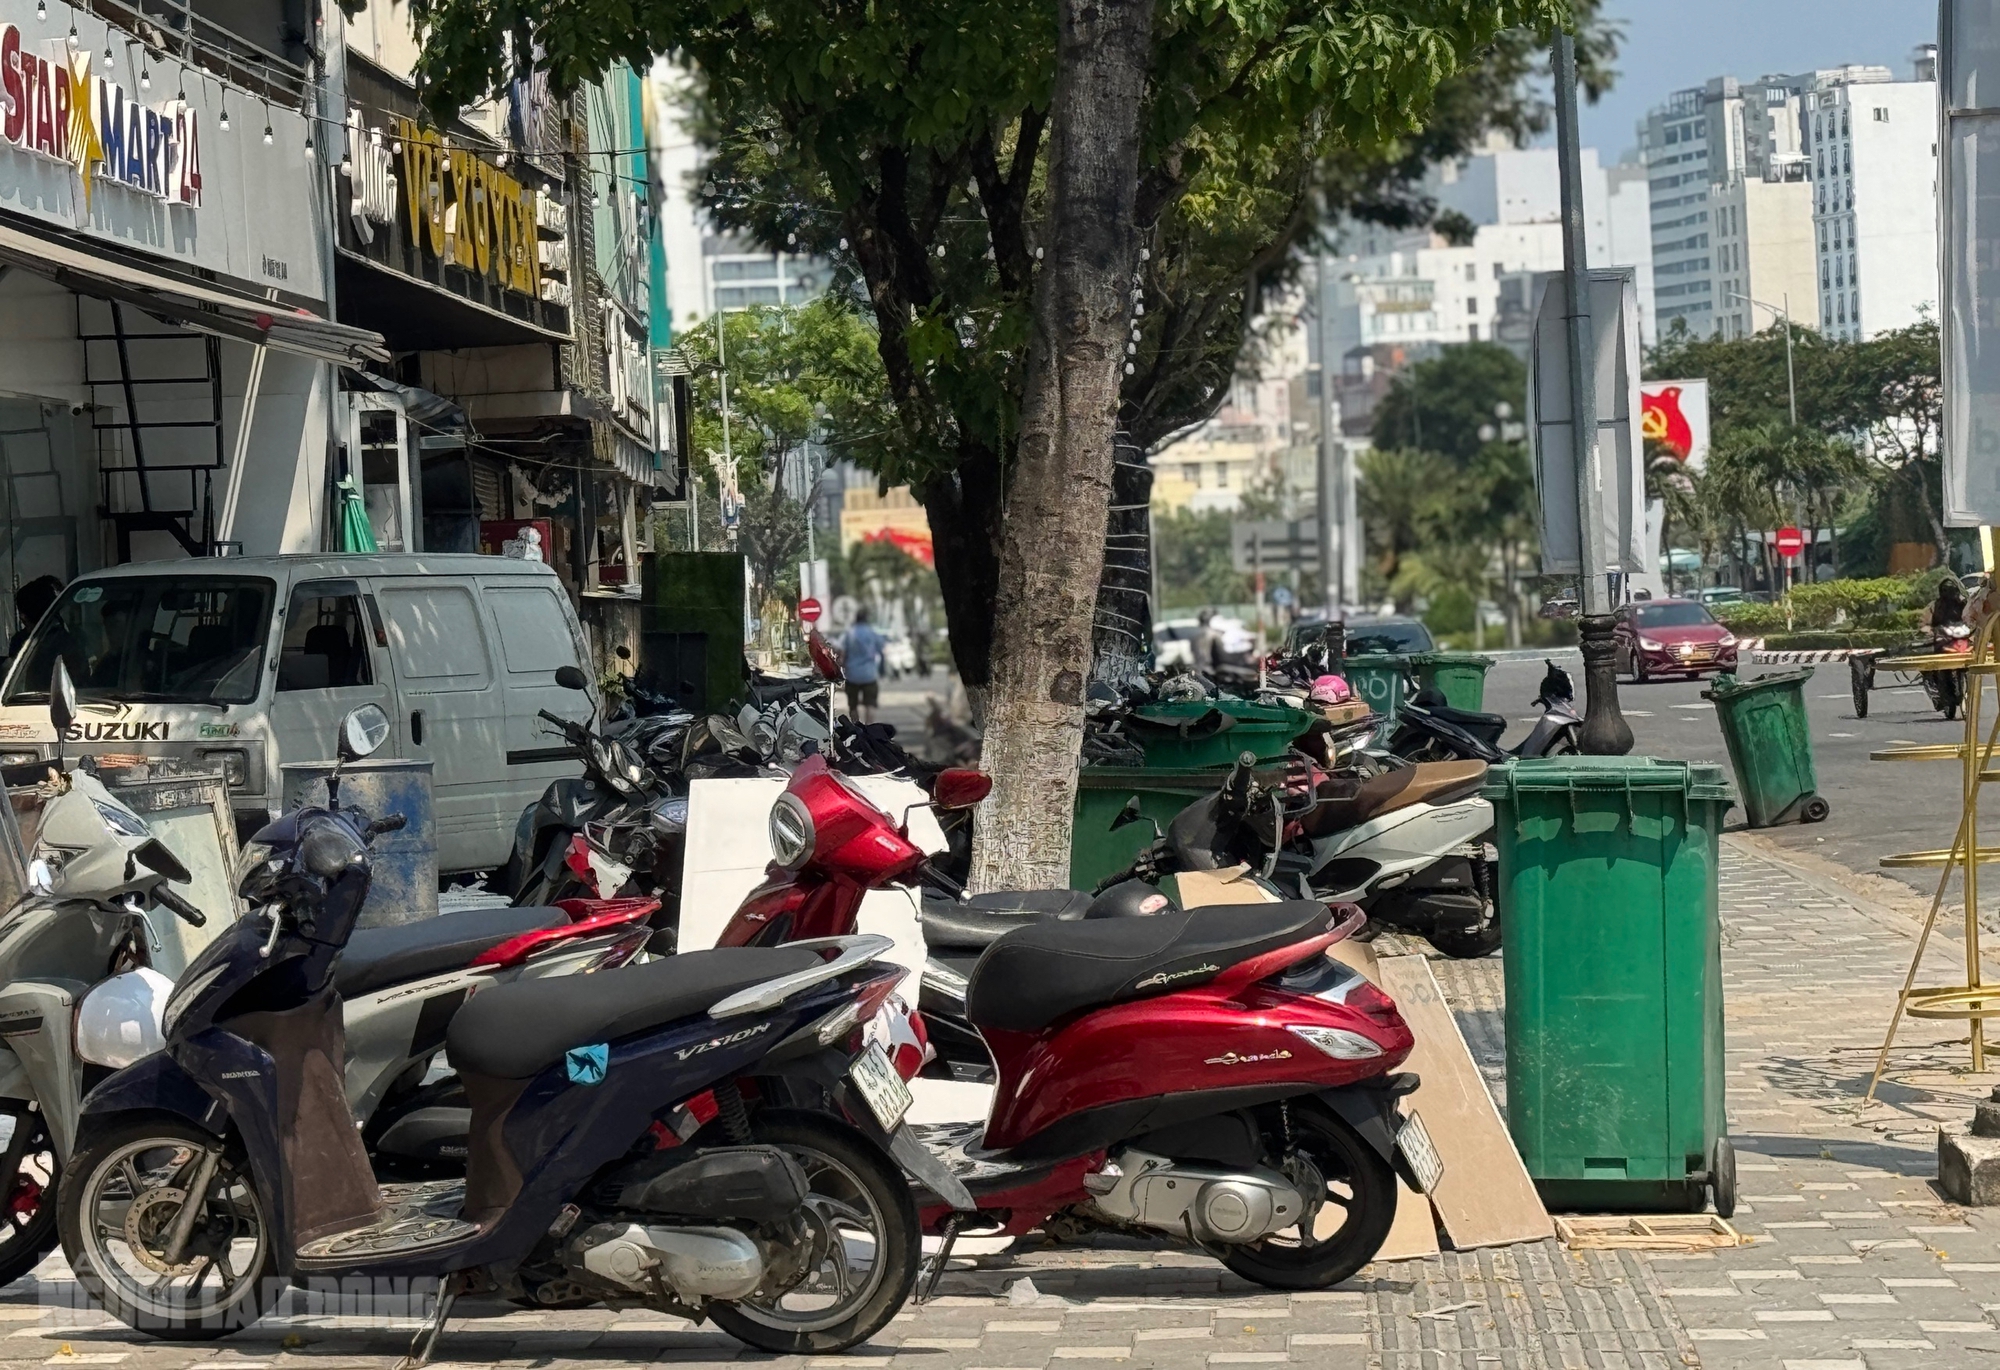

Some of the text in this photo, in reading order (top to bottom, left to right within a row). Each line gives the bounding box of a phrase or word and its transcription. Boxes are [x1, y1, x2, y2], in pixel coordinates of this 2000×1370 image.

[1, 23, 76, 164] STAR
[98, 76, 172, 197] MART
[65, 721, 170, 741] SUZUKI
[673, 1022, 771, 1061] VISION
